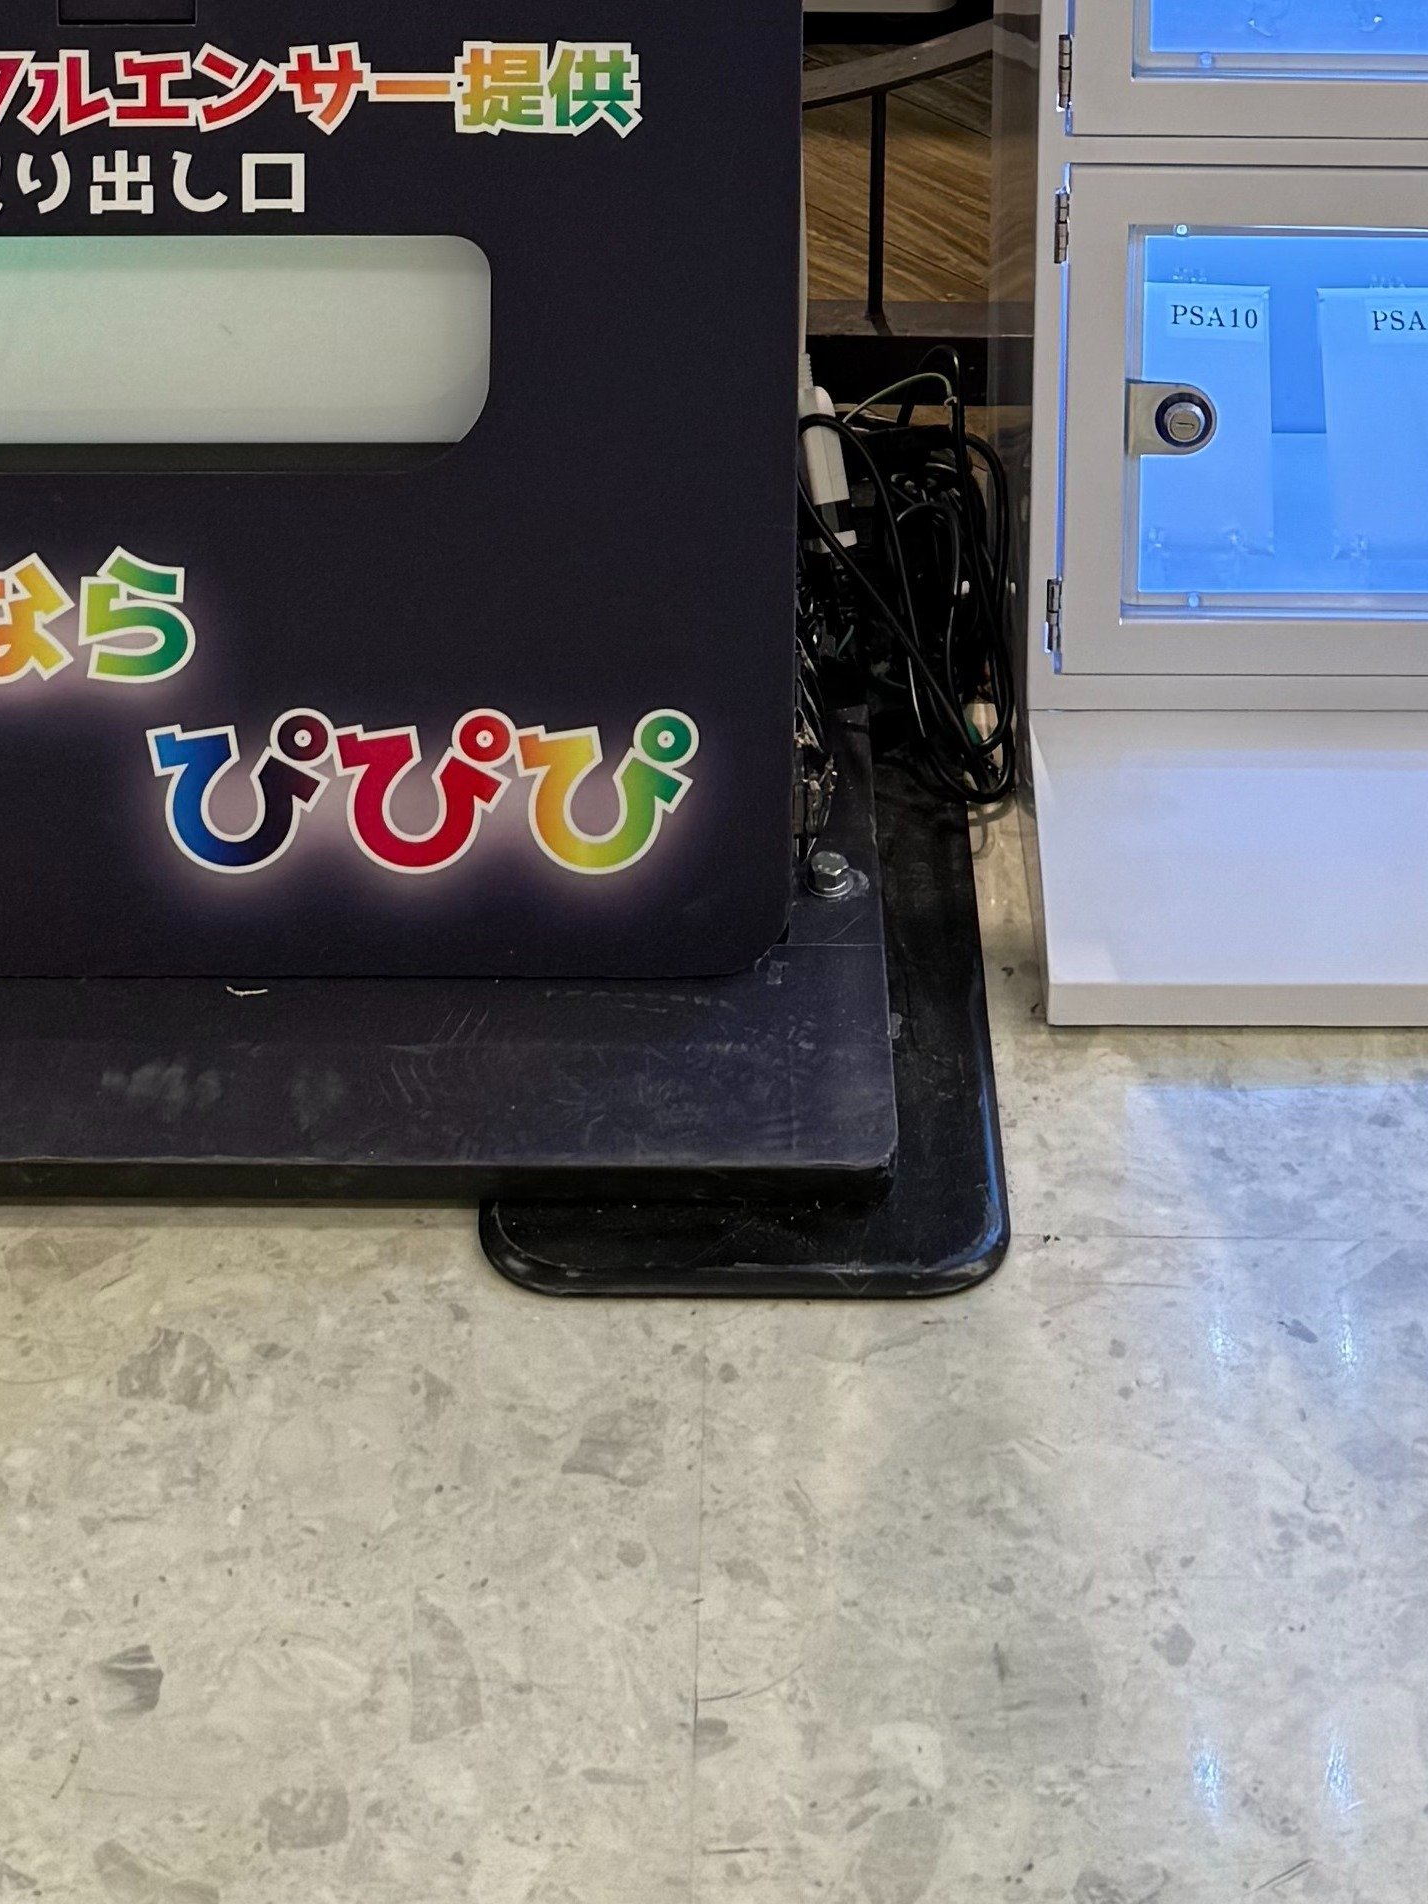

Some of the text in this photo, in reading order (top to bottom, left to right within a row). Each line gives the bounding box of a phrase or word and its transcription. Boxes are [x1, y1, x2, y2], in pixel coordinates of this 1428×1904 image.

[1171, 304, 1260, 330] PSA10
[144, 707, 701, 876] ぴぴぴ
